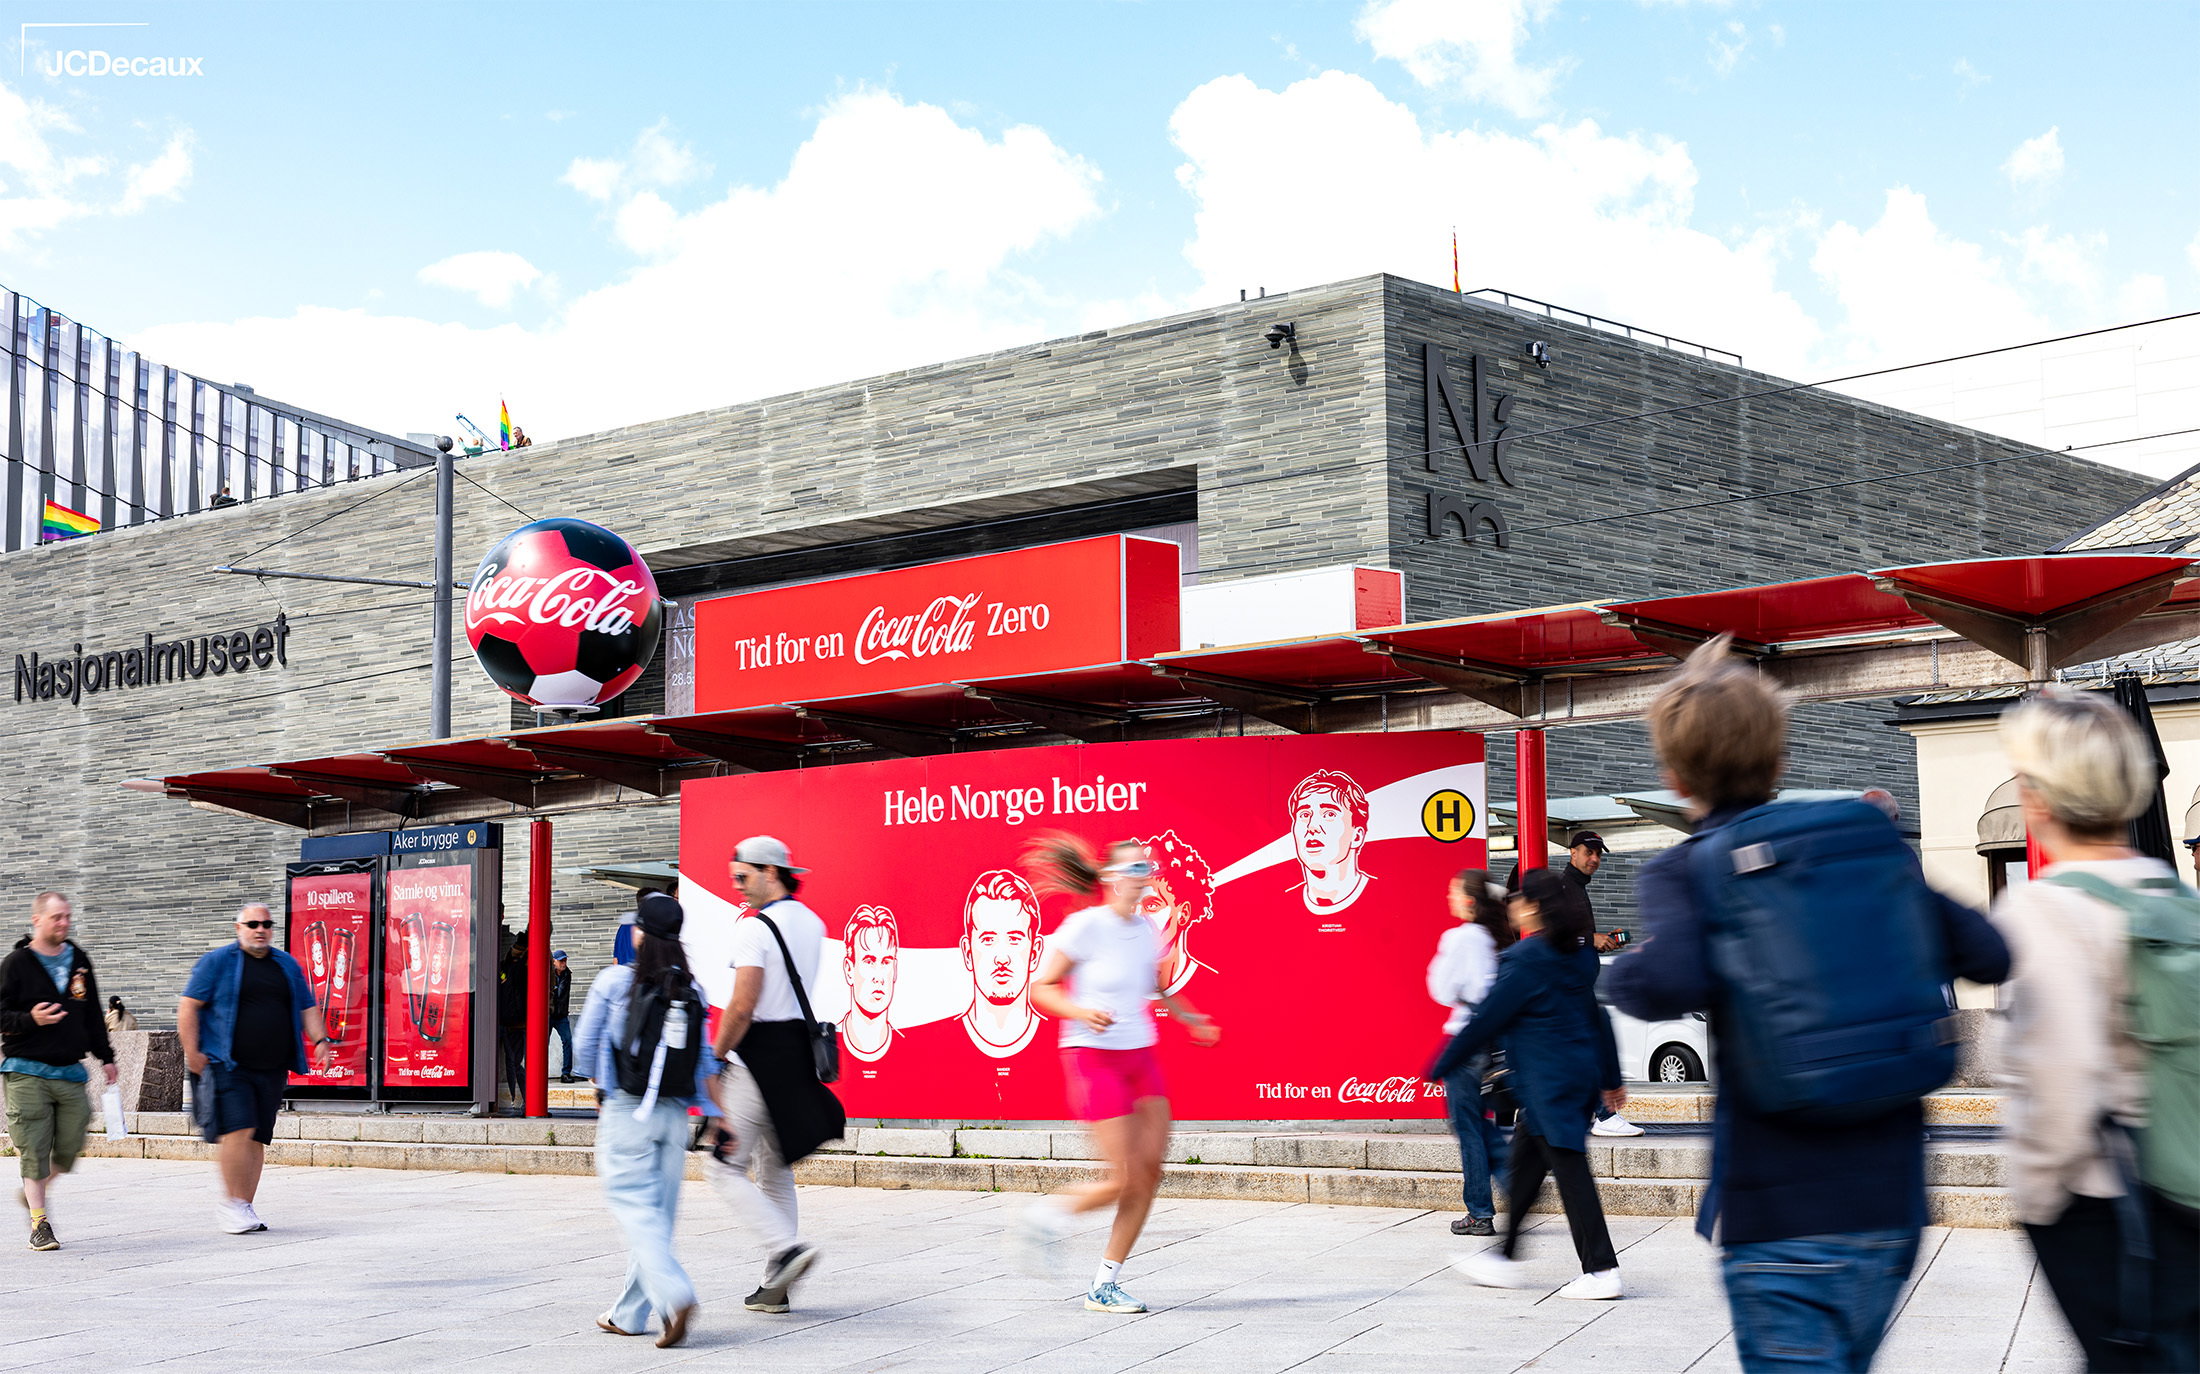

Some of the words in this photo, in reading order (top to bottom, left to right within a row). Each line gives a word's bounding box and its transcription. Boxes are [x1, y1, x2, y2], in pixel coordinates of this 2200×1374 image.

[466, 563, 645, 636] Coca-Cola
[735, 636, 772, 670] Tid
[776, 632, 810, 665] for
[814, 632, 845, 660] en
[854, 591, 984, 665] Coca-Cola
[986, 602, 1050, 636] Zero
[14, 612, 290, 705] Nasjonalmuseet
[884, 787, 944, 826] Hele
[950, 785, 1045, 826] Norge
[1052, 775, 1147, 814] heier
[1436, 800, 1461, 832] H
[393, 834, 419, 849] Aker
[421, 831, 459, 850] brygge
[307, 891, 317, 905] 10
[318, 889, 355, 907] spillere.
[394, 882, 423, 900] Samle
[425, 885, 438, 902] og
[421, 1065, 444, 1078] Coca-Cola
[1256, 1083, 1281, 1098] Tid
[1285, 1083, 1308, 1098] for
[1312, 1085, 1331, 1098] en
[1338, 1076, 1420, 1103] Coca-Cola
